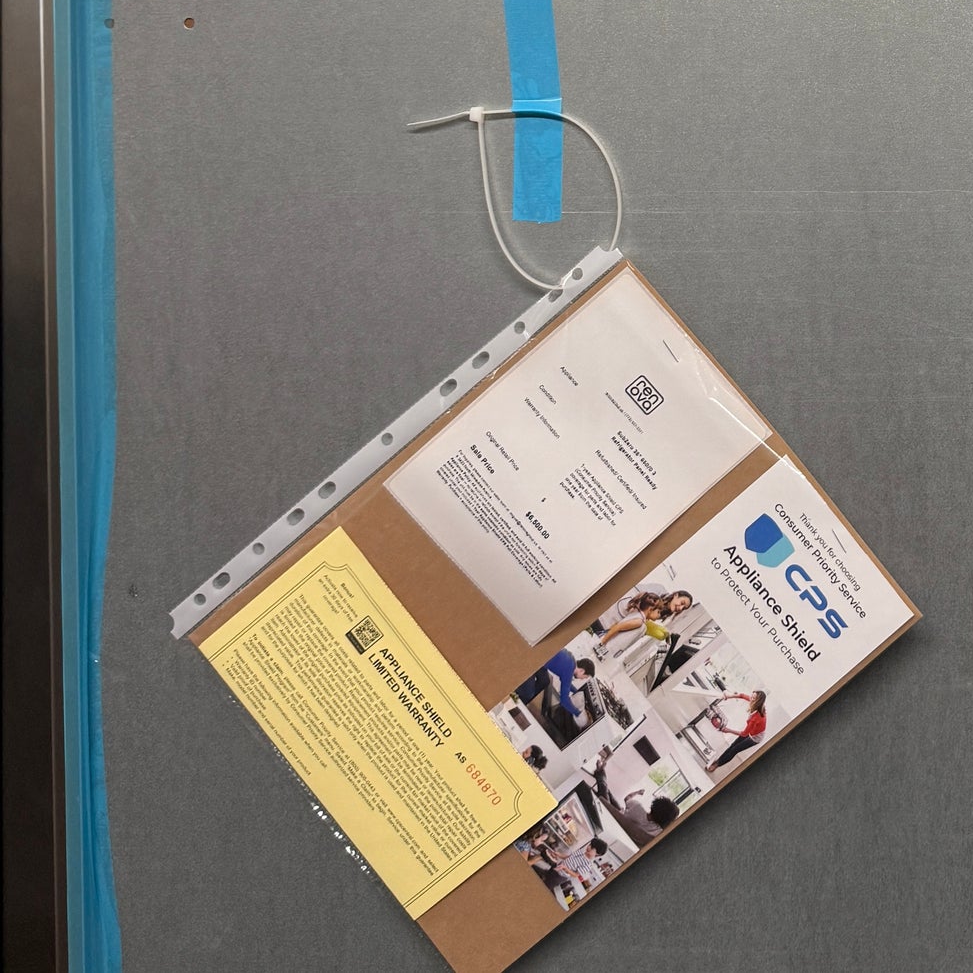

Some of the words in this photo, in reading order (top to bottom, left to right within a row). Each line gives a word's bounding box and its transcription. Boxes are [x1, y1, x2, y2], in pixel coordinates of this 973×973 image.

[538, 384, 558, 405] Condition
[559, 365, 580, 388] Appliance
[522, 397, 542, 418] Warranty
[538, 415, 561, 440] Information
[469, 444, 484, 460] Sale
[480, 457, 497, 475] Price
[484, 430, 502, 450] Original
[498, 446, 512, 461] Retail
[508, 458, 521, 472] Price
[609, 436, 636, 464] Refrigerator
[632, 461, 647, 478] Panel
[643, 474, 658, 491] Ready
[588, 475, 607, 495] Appliance
[631, 492, 648, 510] Insured
[524, 511, 551, 540] $6,500.00
[773, 502, 815, 552] Consumer
[810, 549, 842, 586] Priority
[837, 583, 869, 620] Service
[798, 512, 819, 537] Thank
[833, 557, 863, 592] choosing
[720, 569, 751, 606] Protect
[748, 603, 771, 630] Your
[766, 627, 807, 676] Purchase
[721, 542, 786, 619] Appliance
[780, 613, 822, 662] Shield
[780, 560, 850, 641] CPS
[367, 653, 402, 694] LIMITED
[397, 691, 444, 749] WARRANTY
[378, 646, 426, 704] APPLIANCE
[421, 701, 454, 739] SHIELD
[464, 762, 503, 807] 684870
